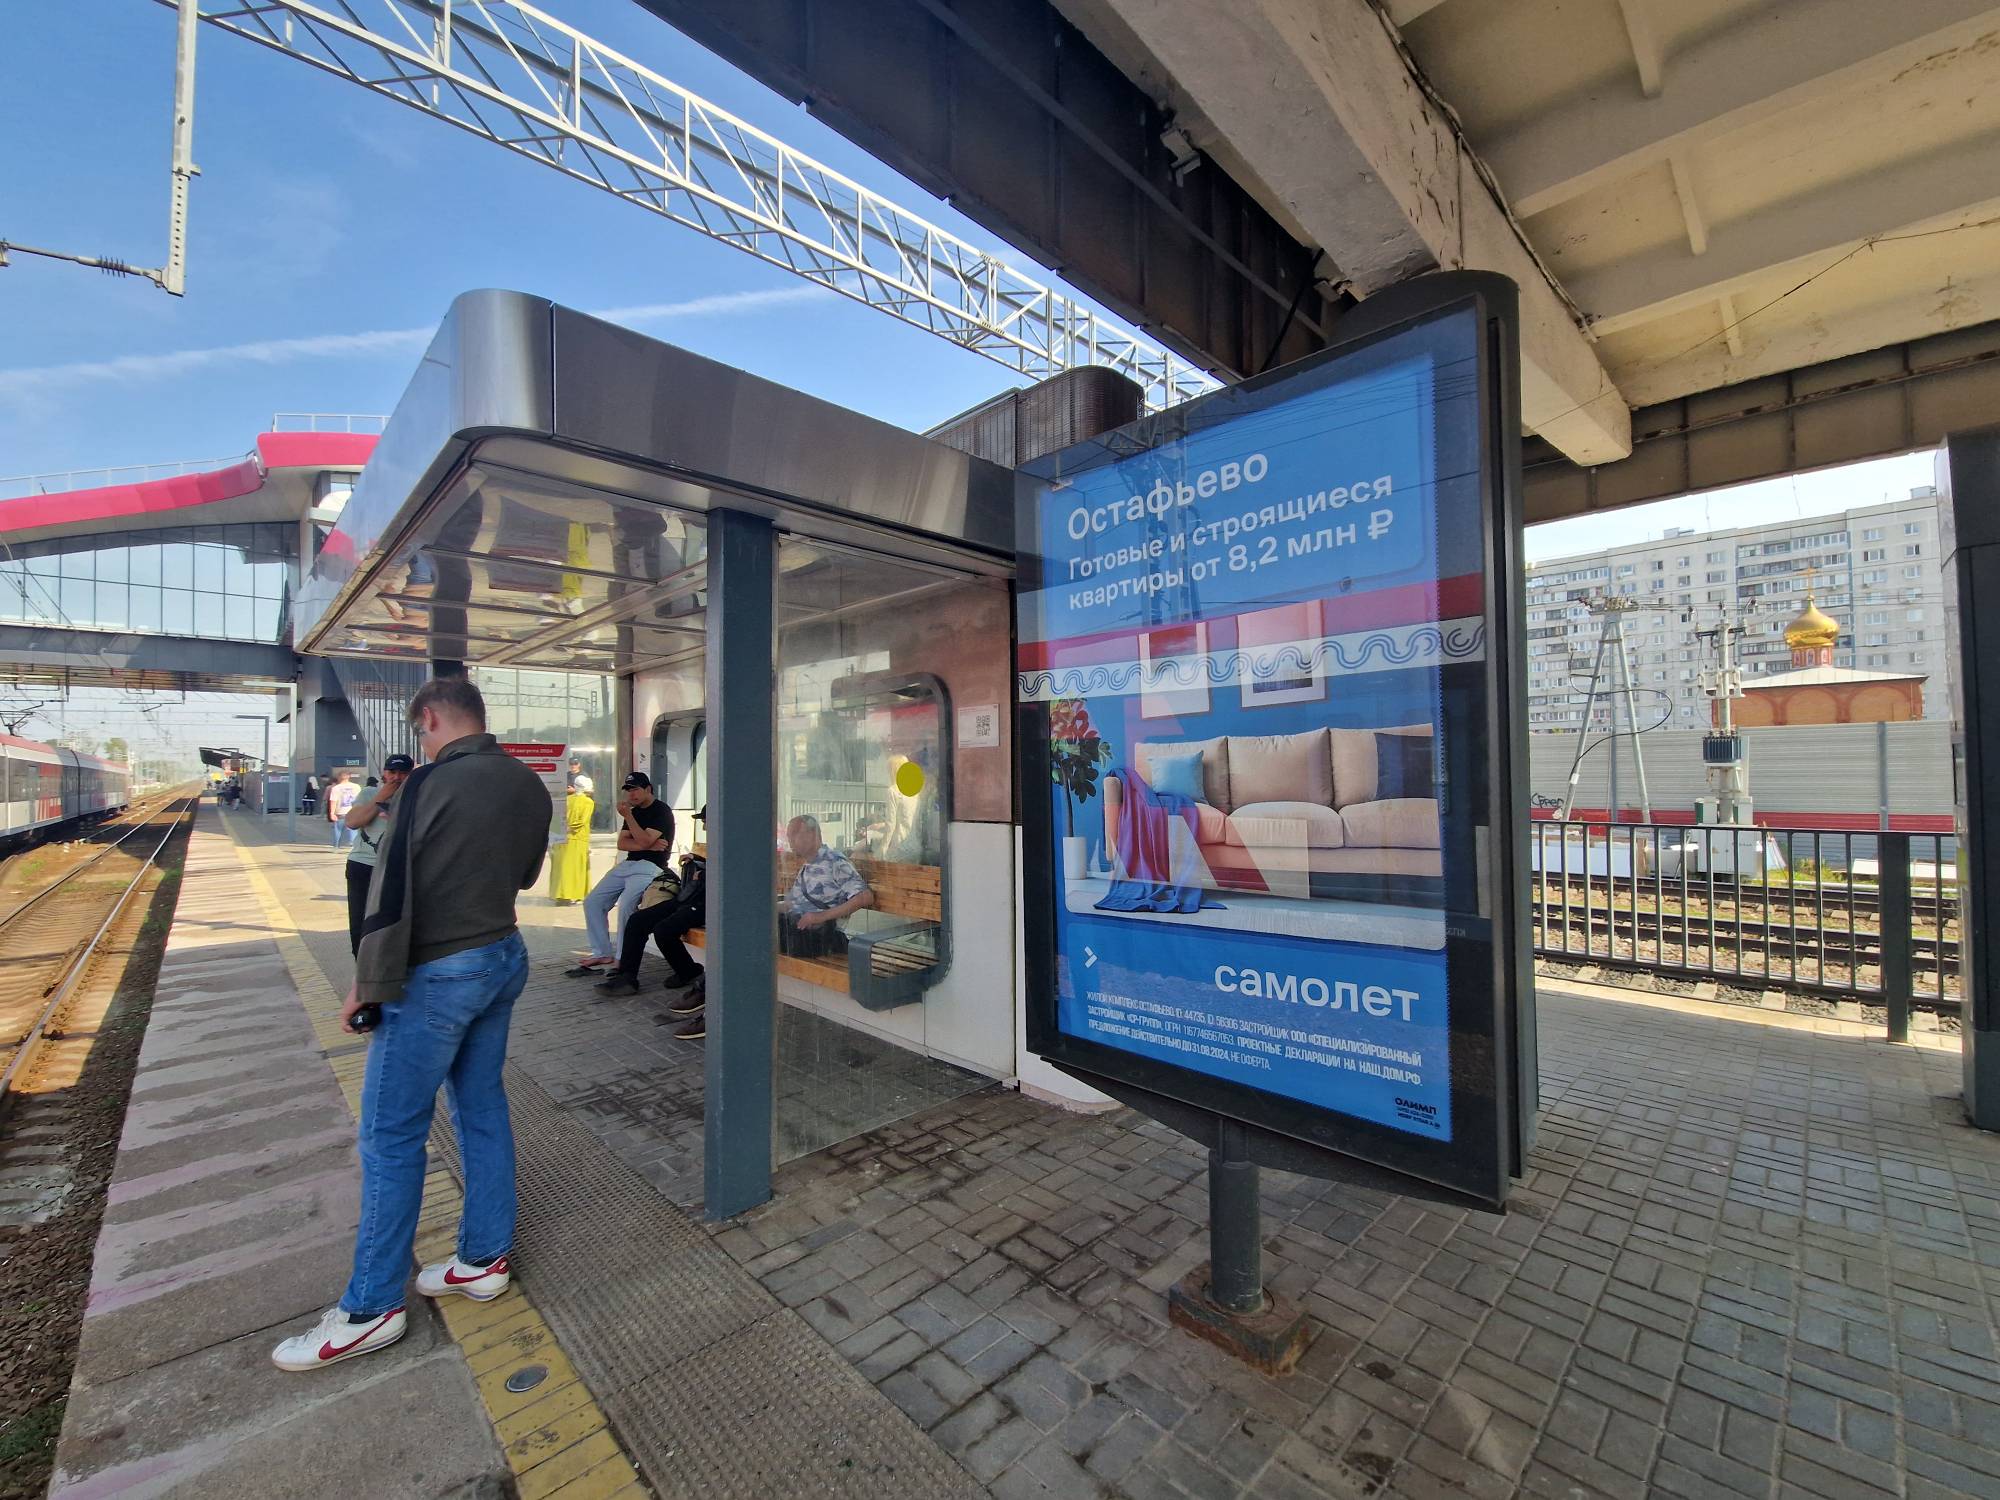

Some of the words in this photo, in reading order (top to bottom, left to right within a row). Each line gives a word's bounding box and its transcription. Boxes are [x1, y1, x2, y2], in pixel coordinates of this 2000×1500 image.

[1068, 453, 1269, 540] Остафьево
[1069, 537, 1163, 580] Готовые
[1171, 534, 1186, 553] и
[1192, 475, 1392, 544] строящиеся
[1069, 567, 1184, 610] квартиры
[1191, 557, 1221, 582] от
[1229, 536, 1279, 573] 8,2
[1288, 523, 1356, 559] млн
[1214, 965, 1420, 1022] самолет
[1231, 1051, 1240, 1063] НЕ
[1237, 1036, 1282, 1056] ПРОЕКТНЫЕ
[1285, 1046, 1341, 1068] ДЕКЛАРАЦИИ
[1344, 1058, 1356, 1071] НА
[1239, 1020, 1289, 1040] ЗАСТРОЙЩИК
[1291, 1030, 1307, 1043] ООО
[1308, 1033, 1422, 1067] «СПЕЦИАЛИЗИРОВАННЫЙ
